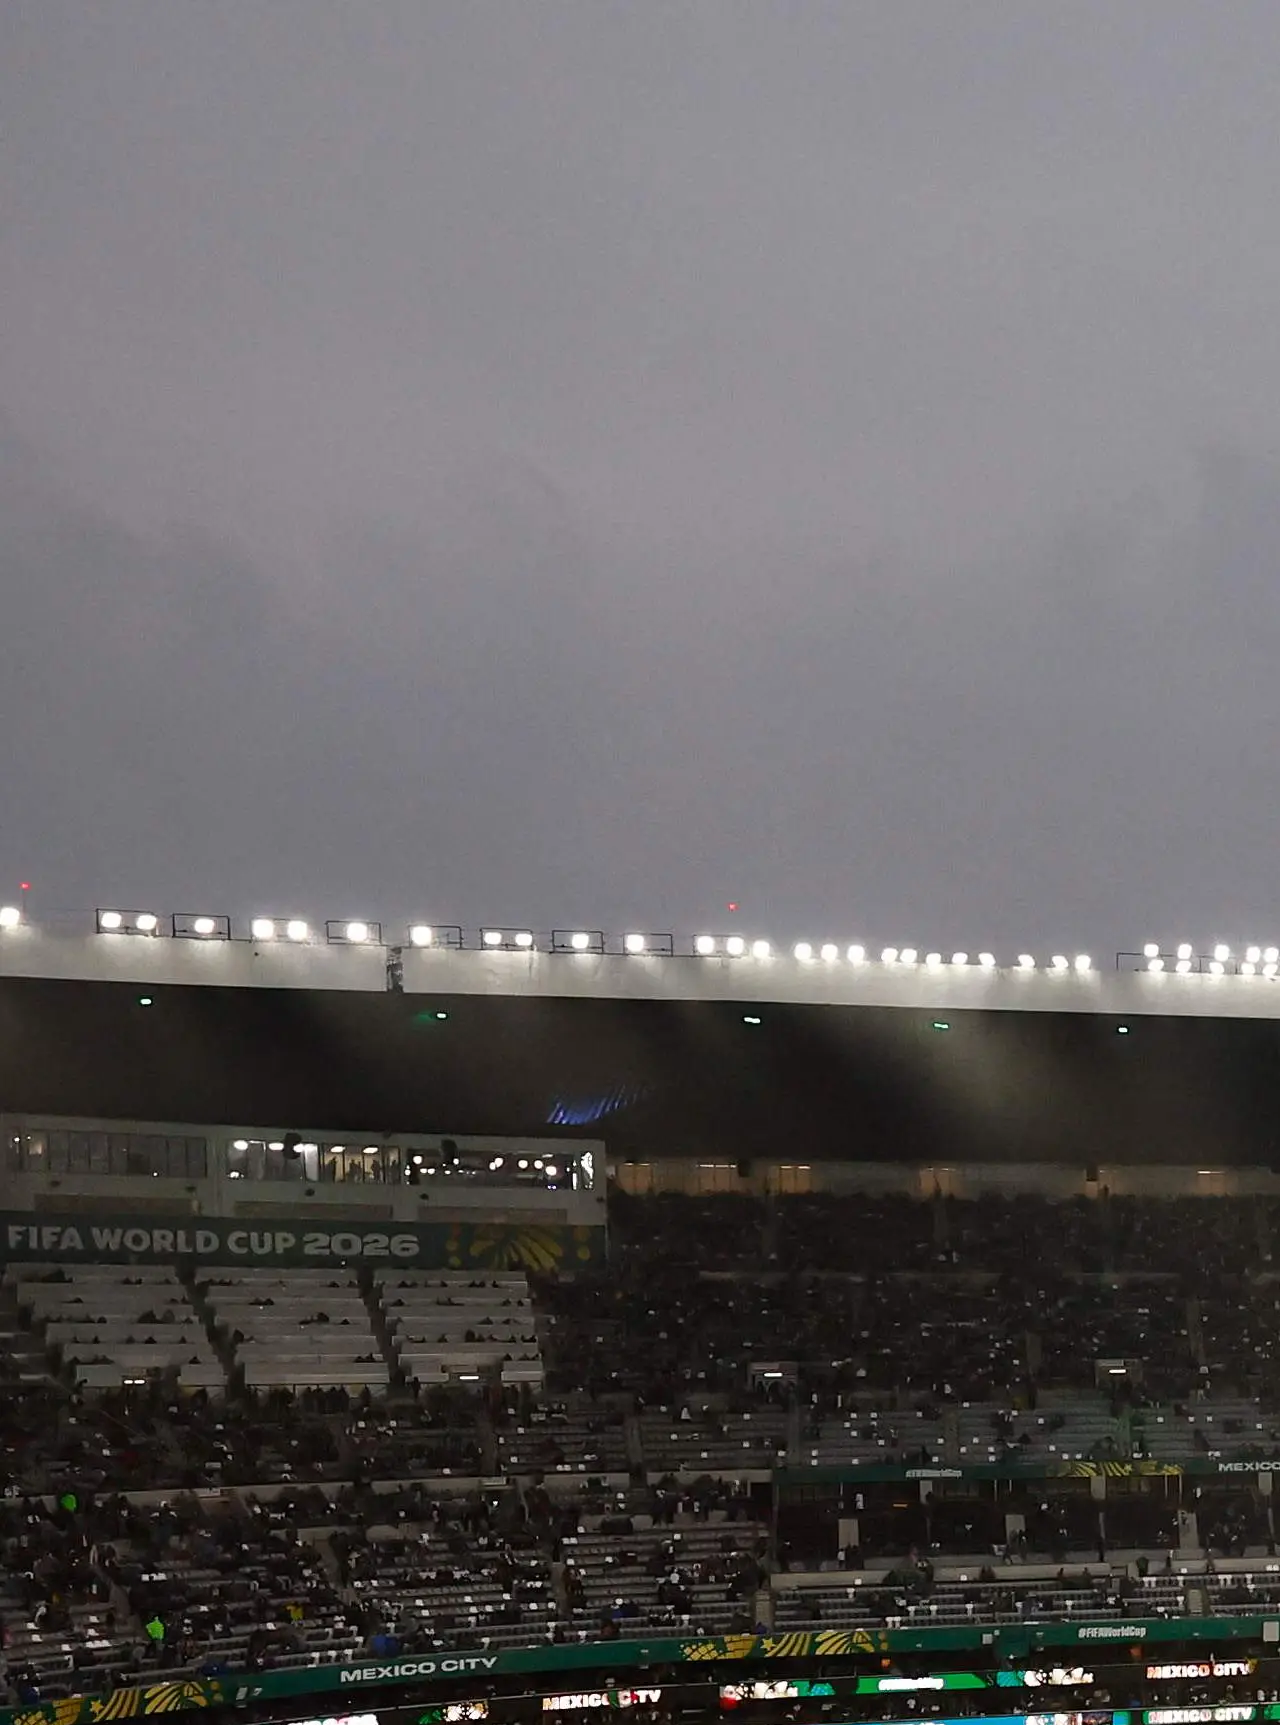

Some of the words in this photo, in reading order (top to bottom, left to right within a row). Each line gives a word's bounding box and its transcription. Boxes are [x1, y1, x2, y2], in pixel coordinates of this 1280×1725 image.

[7, 1224, 84, 1251] FIFA
[91, 1225, 219, 1255] WORLD
[227, 1230, 296, 1257] CUP
[303, 1232, 419, 1258] 2026
[1078, 1625, 1147, 1640] #FIFAWorldCup
[340, 1661, 437, 1683] MEXICO
[440, 1656, 498, 1674] CITY
[1147, 1662, 1211, 1679] MEXICO
[1148, 1707, 1212, 1725] MEXICO
[1214, 1705, 1254, 1721] CITY
